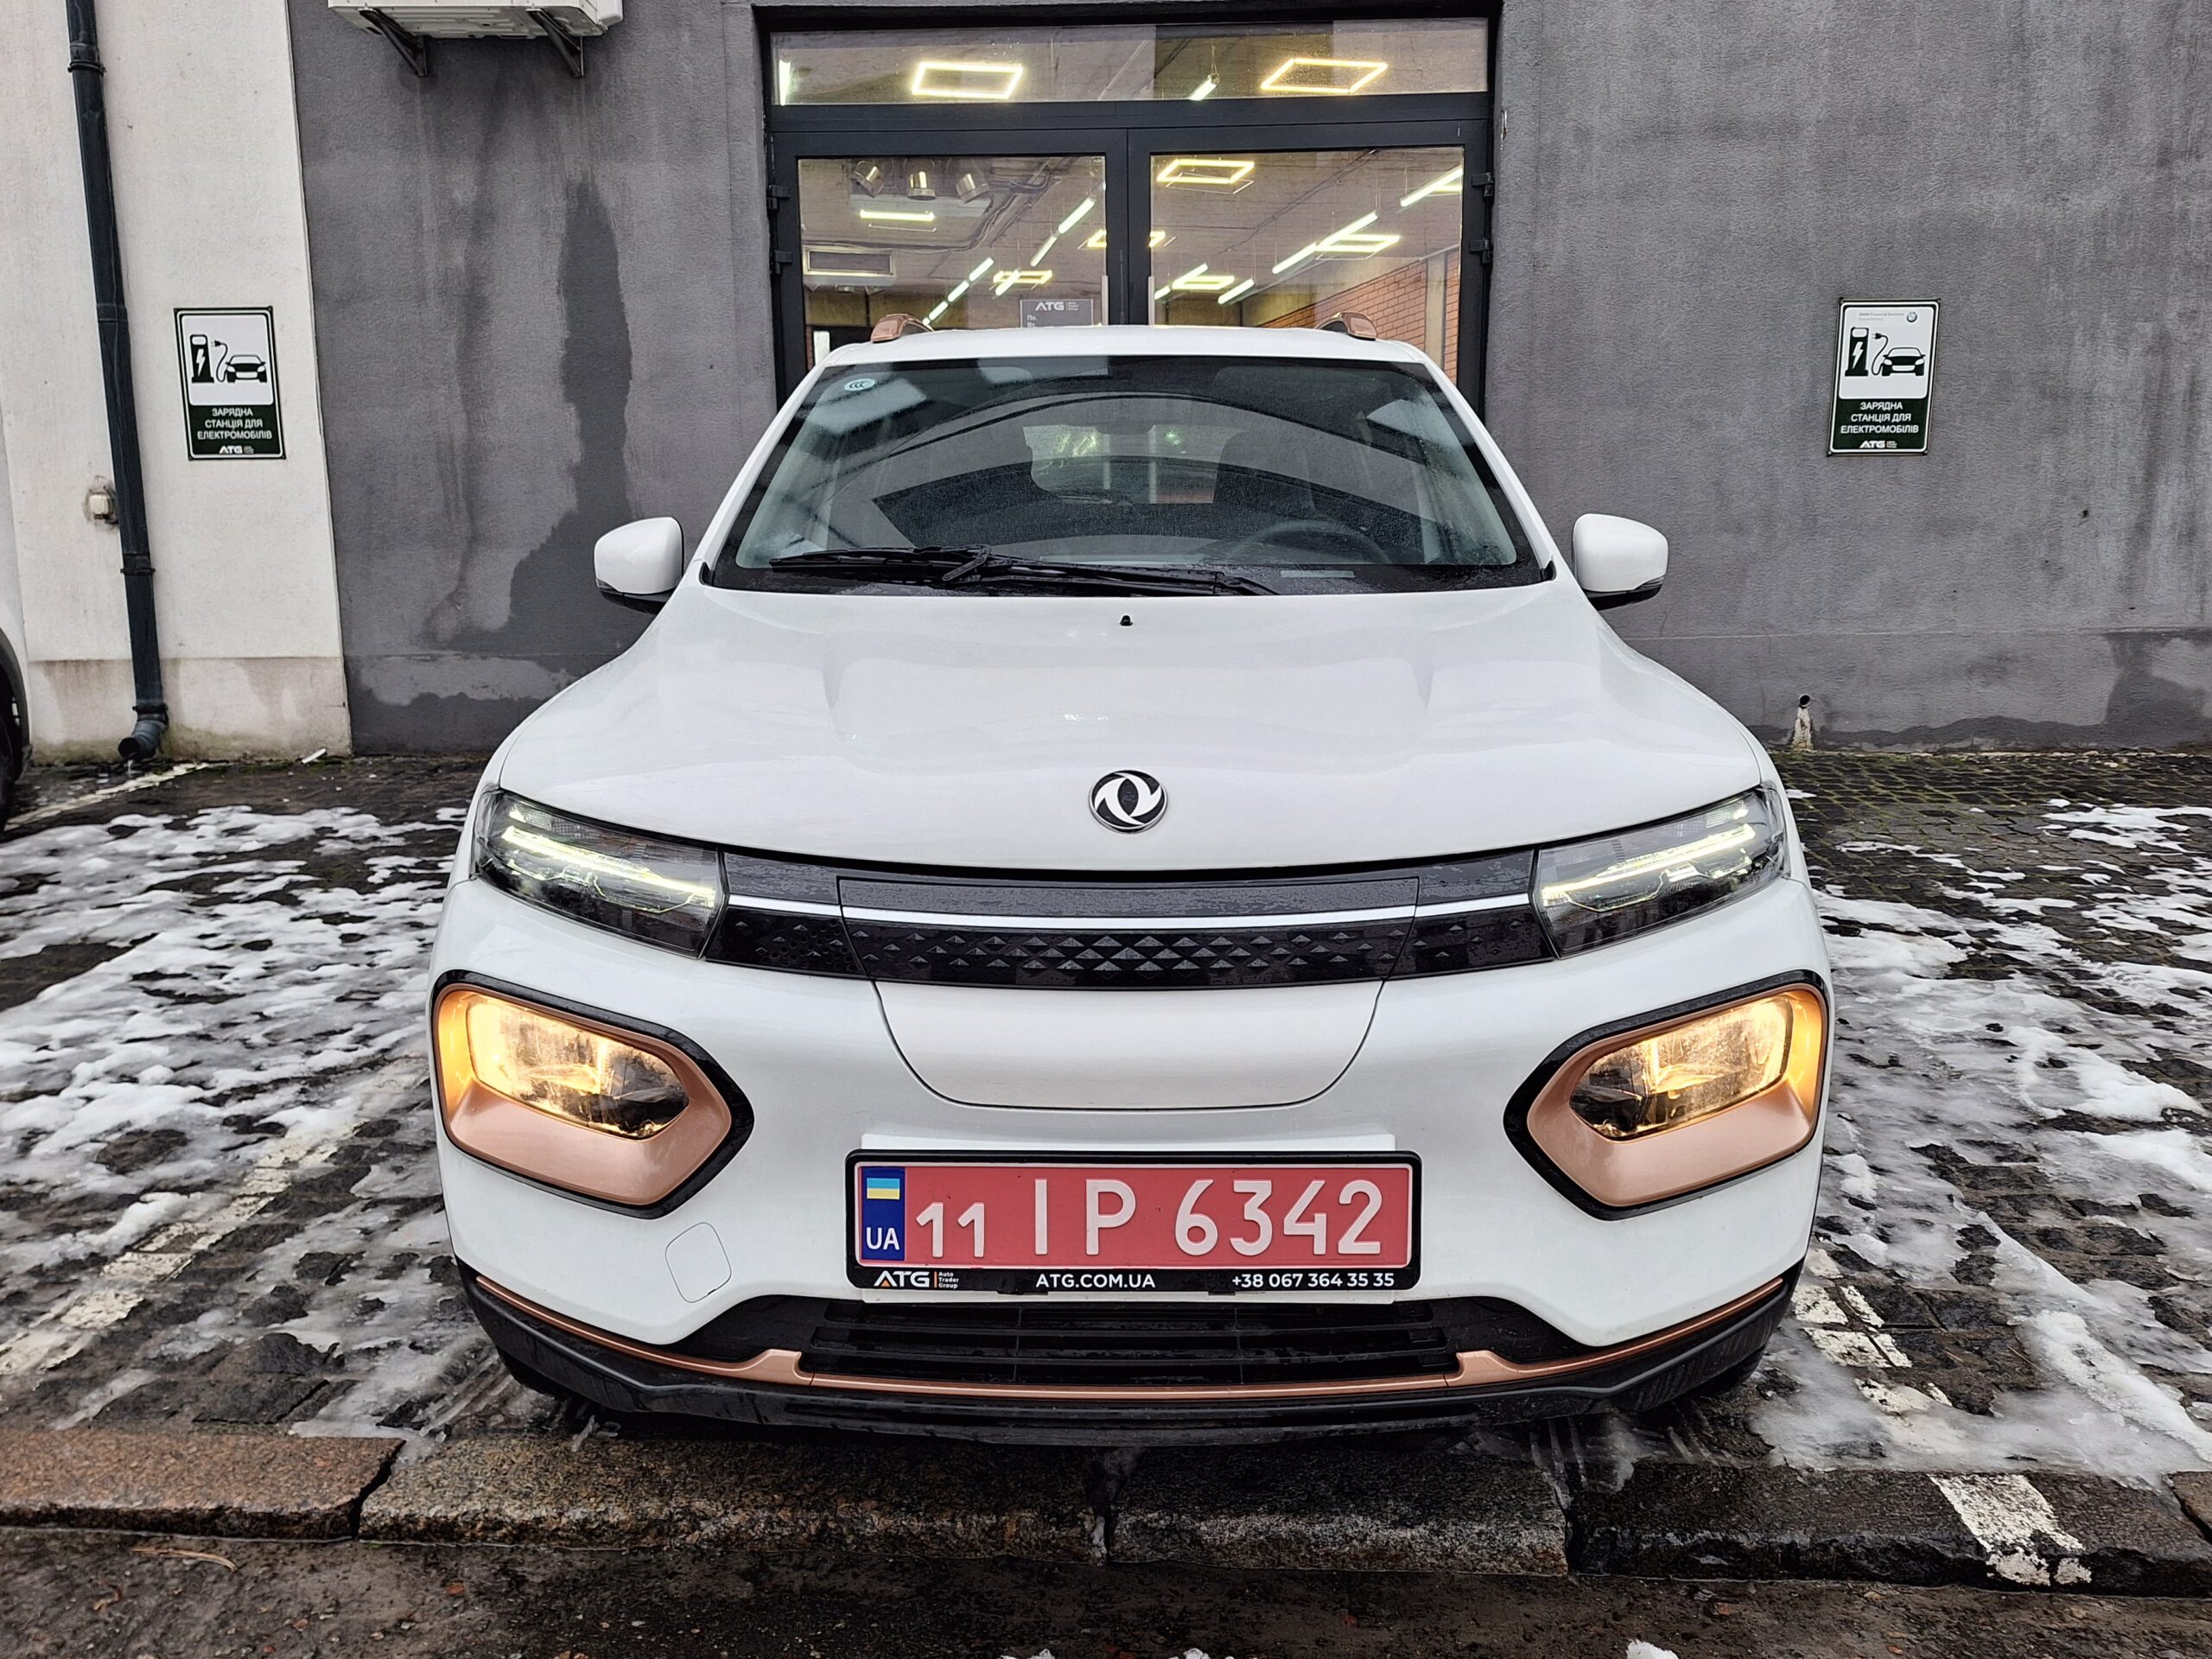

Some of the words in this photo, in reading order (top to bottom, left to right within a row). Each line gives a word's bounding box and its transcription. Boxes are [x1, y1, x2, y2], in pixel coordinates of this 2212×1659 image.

[1035, 302, 1065, 311] ATG
[1860, 402, 1903, 411] ЗАРЯДНА
[212, 408, 253, 417] ЗАРЯДНА
[1851, 413, 1891, 423] СТАНЦІЯ
[1891, 413, 1911, 423] ДЛЯ
[205, 419, 243, 429] СТАНЦІЯ
[245, 419, 263, 429] ДЛЯ
[1840, 425, 1919, 434] ЕЛЕКТРОМОБІЛІВ
[197, 430, 272, 440] ЕЛЕКТРОМОБІЛІВ
[219, 445, 243, 454] ATG
[916, 1202, 985, 1258] 11
[1175, 1179, 1382, 1255] 6342
[866, 1227, 900, 1250] UA
[874, 1270, 930, 1287] ATG
[1036, 1274, 1155, 1288] ATG.COM.UA
[1232, 1274, 1263, 1287] +38
[1268, 1274, 1303, 1287] 067
[1307, 1273, 1343, 1287] 364
[1347, 1273, 1369, 1287] 35
[1373, 1273, 1395, 1287] 35
